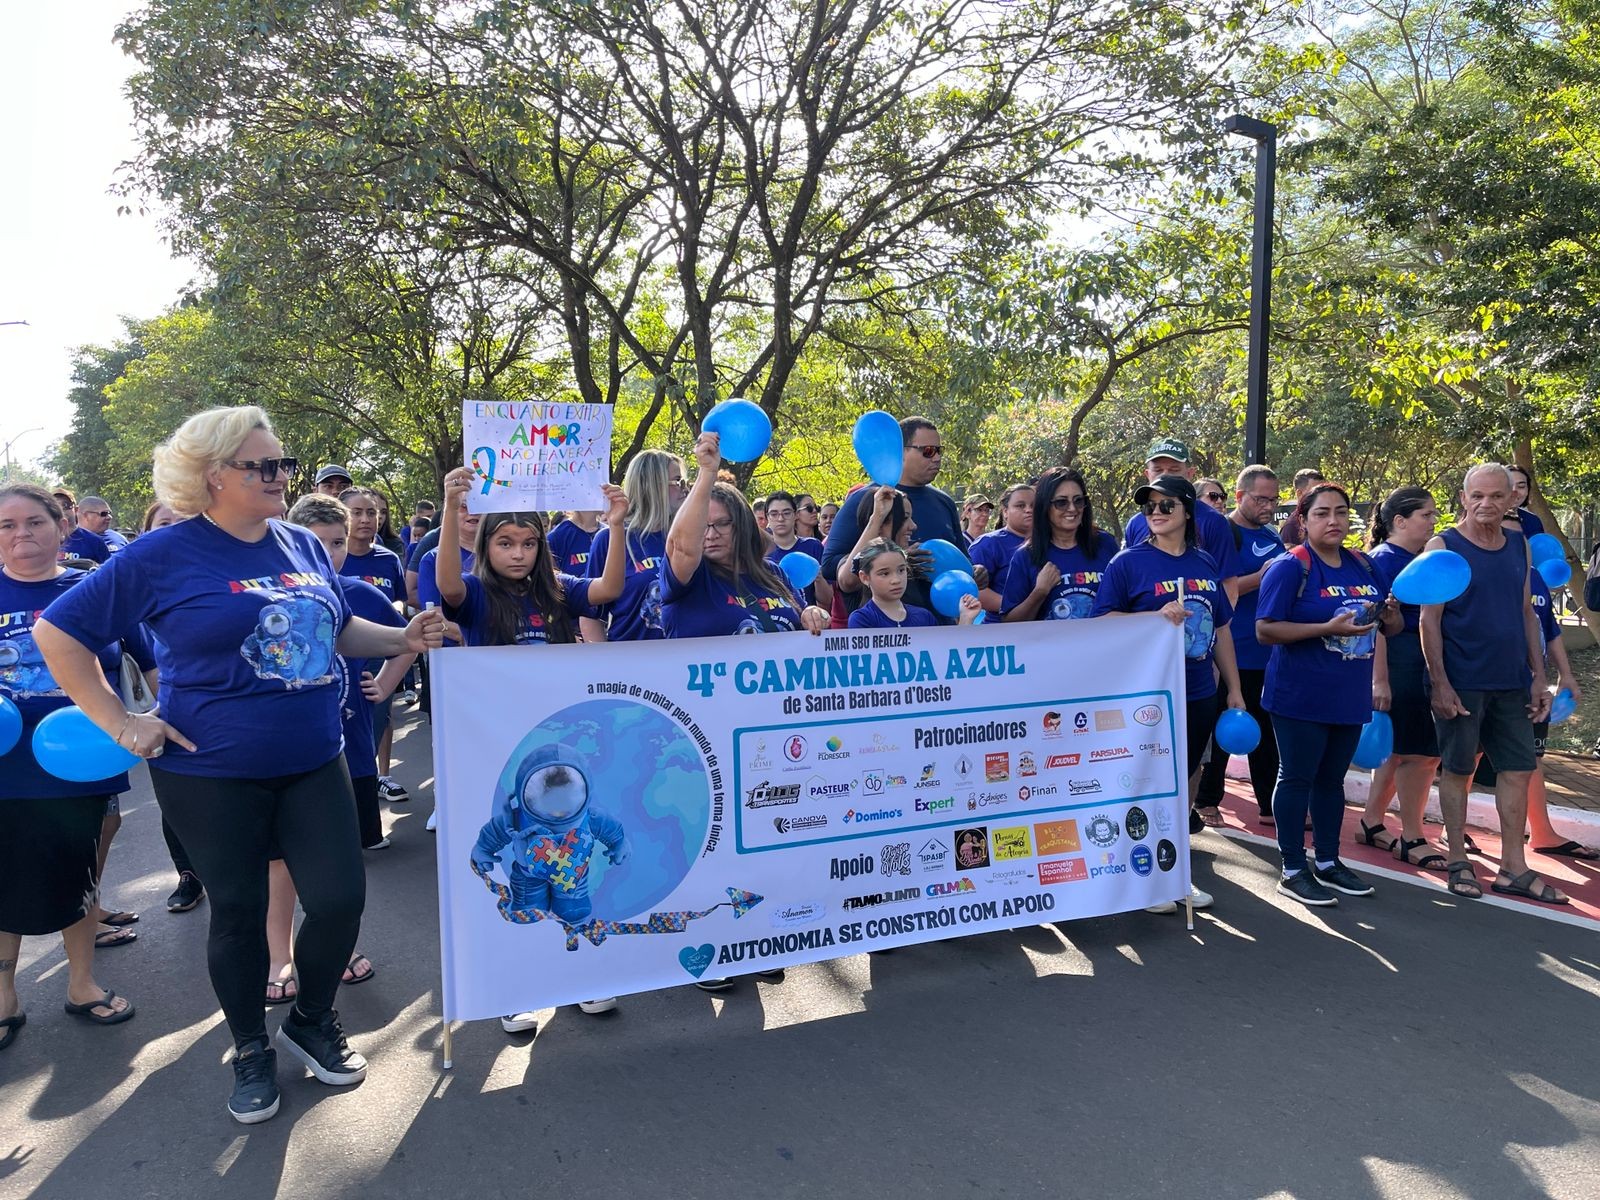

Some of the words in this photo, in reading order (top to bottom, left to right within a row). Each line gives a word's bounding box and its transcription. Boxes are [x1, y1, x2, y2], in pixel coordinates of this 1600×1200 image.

[475, 403, 560, 420] ENQUANTO
[508, 422, 580, 447] AMOR
[501, 447, 534, 460] NÃO
[538, 444, 593, 460] HAVERÁ
[825, 635, 850, 652] AMAI
[852, 635, 870, 650] SBO
[872, 634, 911, 648] REALIZA:
[734, 650, 938, 695] CAMINHADA
[944, 645, 1026, 680] AZUL
[588, 684, 594, 694] a
[597, 682, 627, 694] magia
[629, 684, 642, 697] de
[643, 689, 675, 712] orbitar
[783, 696, 801, 715] de
[806, 692, 845, 713] Santa
[849, 688, 901, 710] Barbara
[672, 706, 692, 726] pelo
[688, 723, 712, 754] mundo
[914, 720, 1027, 749] Patrocinadores
[706, 754, 718, 768] de
[1090, 747, 1130, 758] FARSURA
[710, 768, 723, 790] uma
[914, 780, 940, 788] JUNSEG
[810, 783, 850, 796] PASTEUR
[1032, 784, 1057, 796] Finan
[713, 792, 724, 822] forma
[915, 796, 955, 814] Expert
[792, 814, 827, 824] CANOVA
[856, 808, 903, 823] Domino's
[830, 854, 874, 881] Apoio
[1041, 867, 1072, 876] Espanhol
[1090, 864, 1126, 878] protea
[718, 928, 835, 964] AUTONOMIA
[839, 922, 862, 944] SE
[866, 905, 957, 938] CONSTRÓI
[959, 900, 998, 923] COM
[1002, 892, 1055, 918] APOIO
